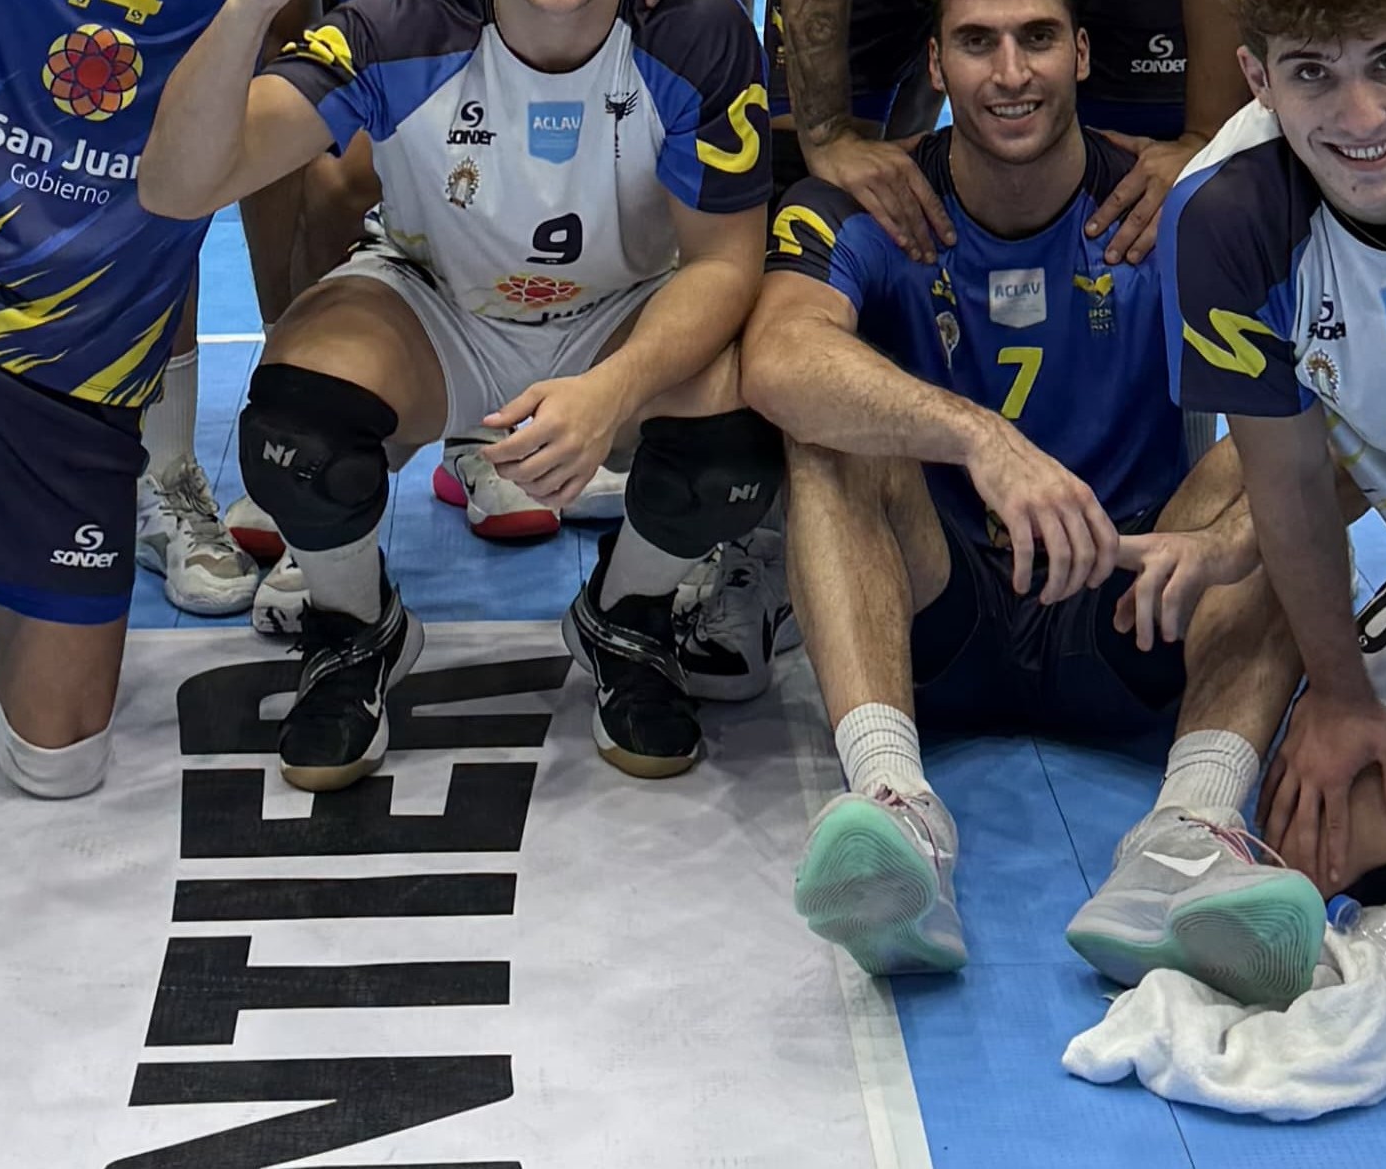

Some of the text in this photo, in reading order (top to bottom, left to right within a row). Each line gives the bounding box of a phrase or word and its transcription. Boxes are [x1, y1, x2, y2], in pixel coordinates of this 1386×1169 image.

[533, 115, 582, 131] ACLAV
[10, 162, 111, 205] Gobierno
[525, 211, 584, 266] 9
[993, 280, 1042, 300] ACLAV
[997, 346, 1044, 420] 7
